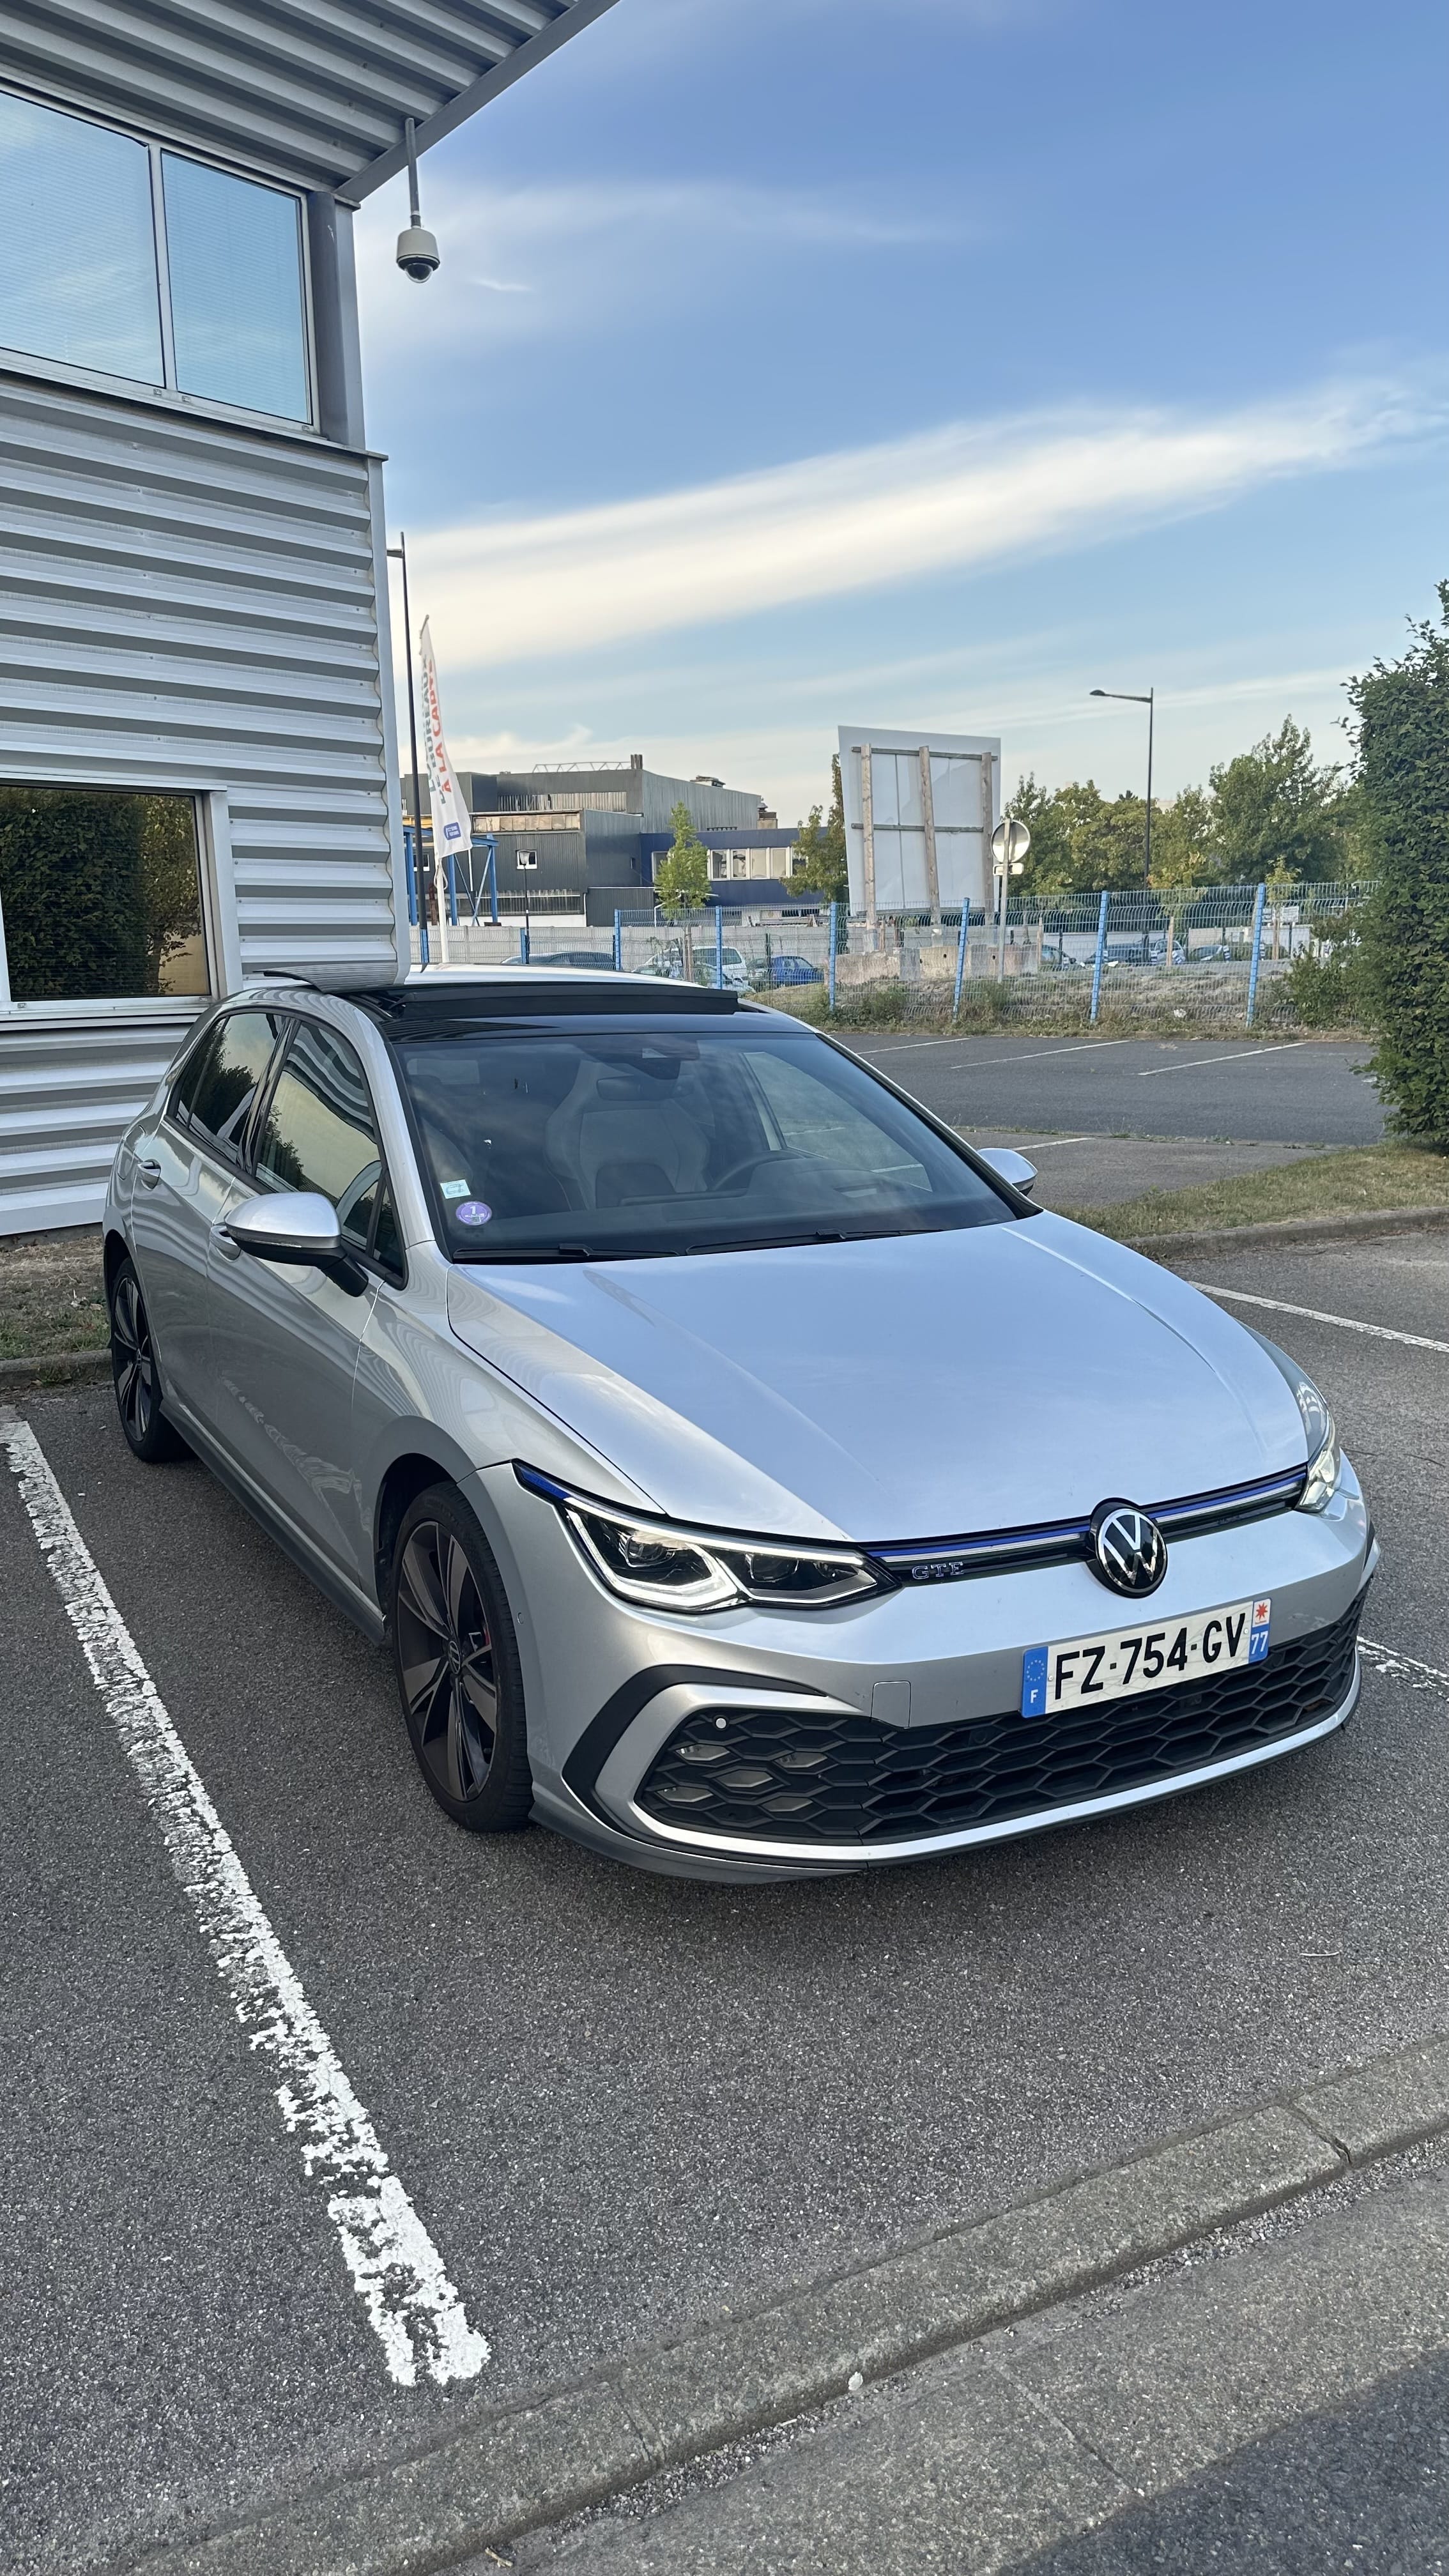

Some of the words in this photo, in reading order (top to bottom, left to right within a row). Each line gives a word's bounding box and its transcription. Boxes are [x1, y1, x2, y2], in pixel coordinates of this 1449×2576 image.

[435, 742, 447, 773] LA
[470, 1206, 477, 1215] 1
[1097, 1508, 1167, 1593] VW
[911, 1560, 965, 1580] GTE
[1030, 1689, 1039, 1704] F
[1054, 1612, 1246, 1701] FZ-754-GV
[1250, 1630, 1269, 1655] 77
